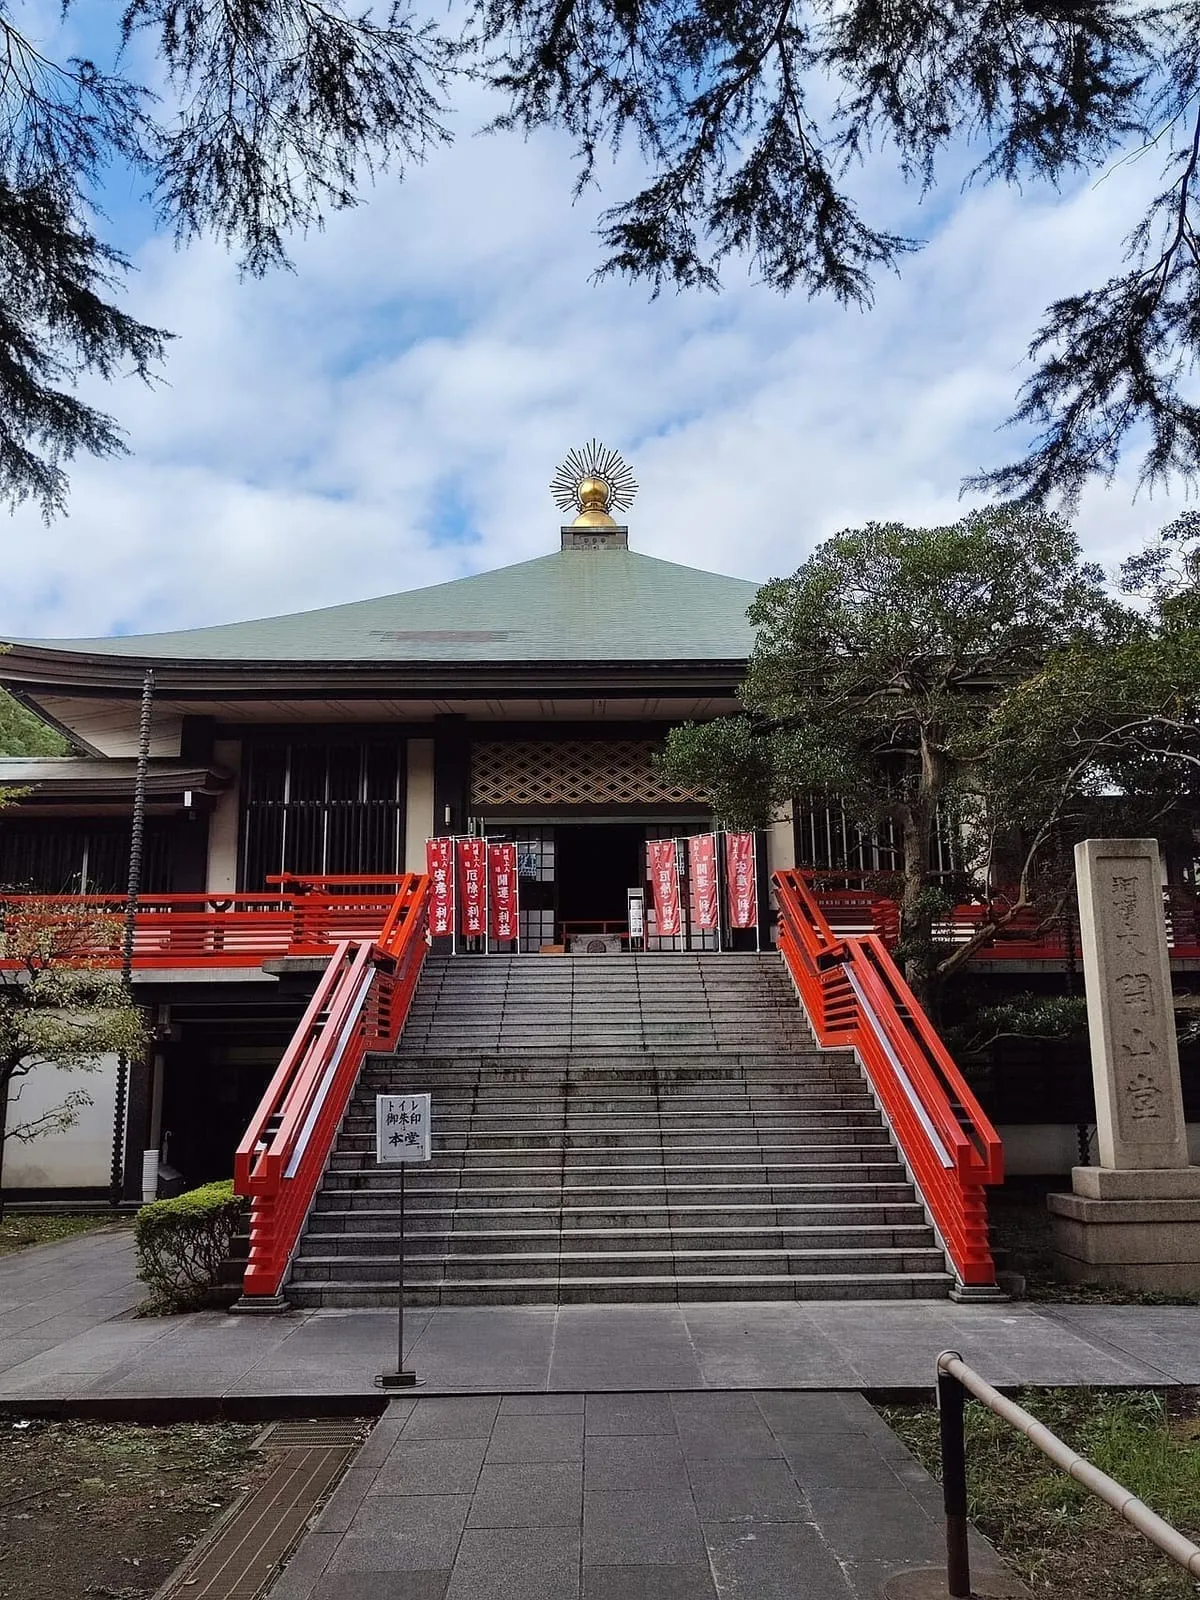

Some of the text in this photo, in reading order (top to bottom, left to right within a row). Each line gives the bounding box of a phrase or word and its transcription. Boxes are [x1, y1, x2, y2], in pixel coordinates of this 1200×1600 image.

[434, 868, 447, 932] 安産ご利益
[466, 869, 480, 930] 厄除ご利益
[497, 873, 510, 935] 開運ご利益
[386, 1112, 421, 1126] 御朱印
[389, 1100, 419, 1112] トイレ
[388, 1132, 420, 1147] 本堂
